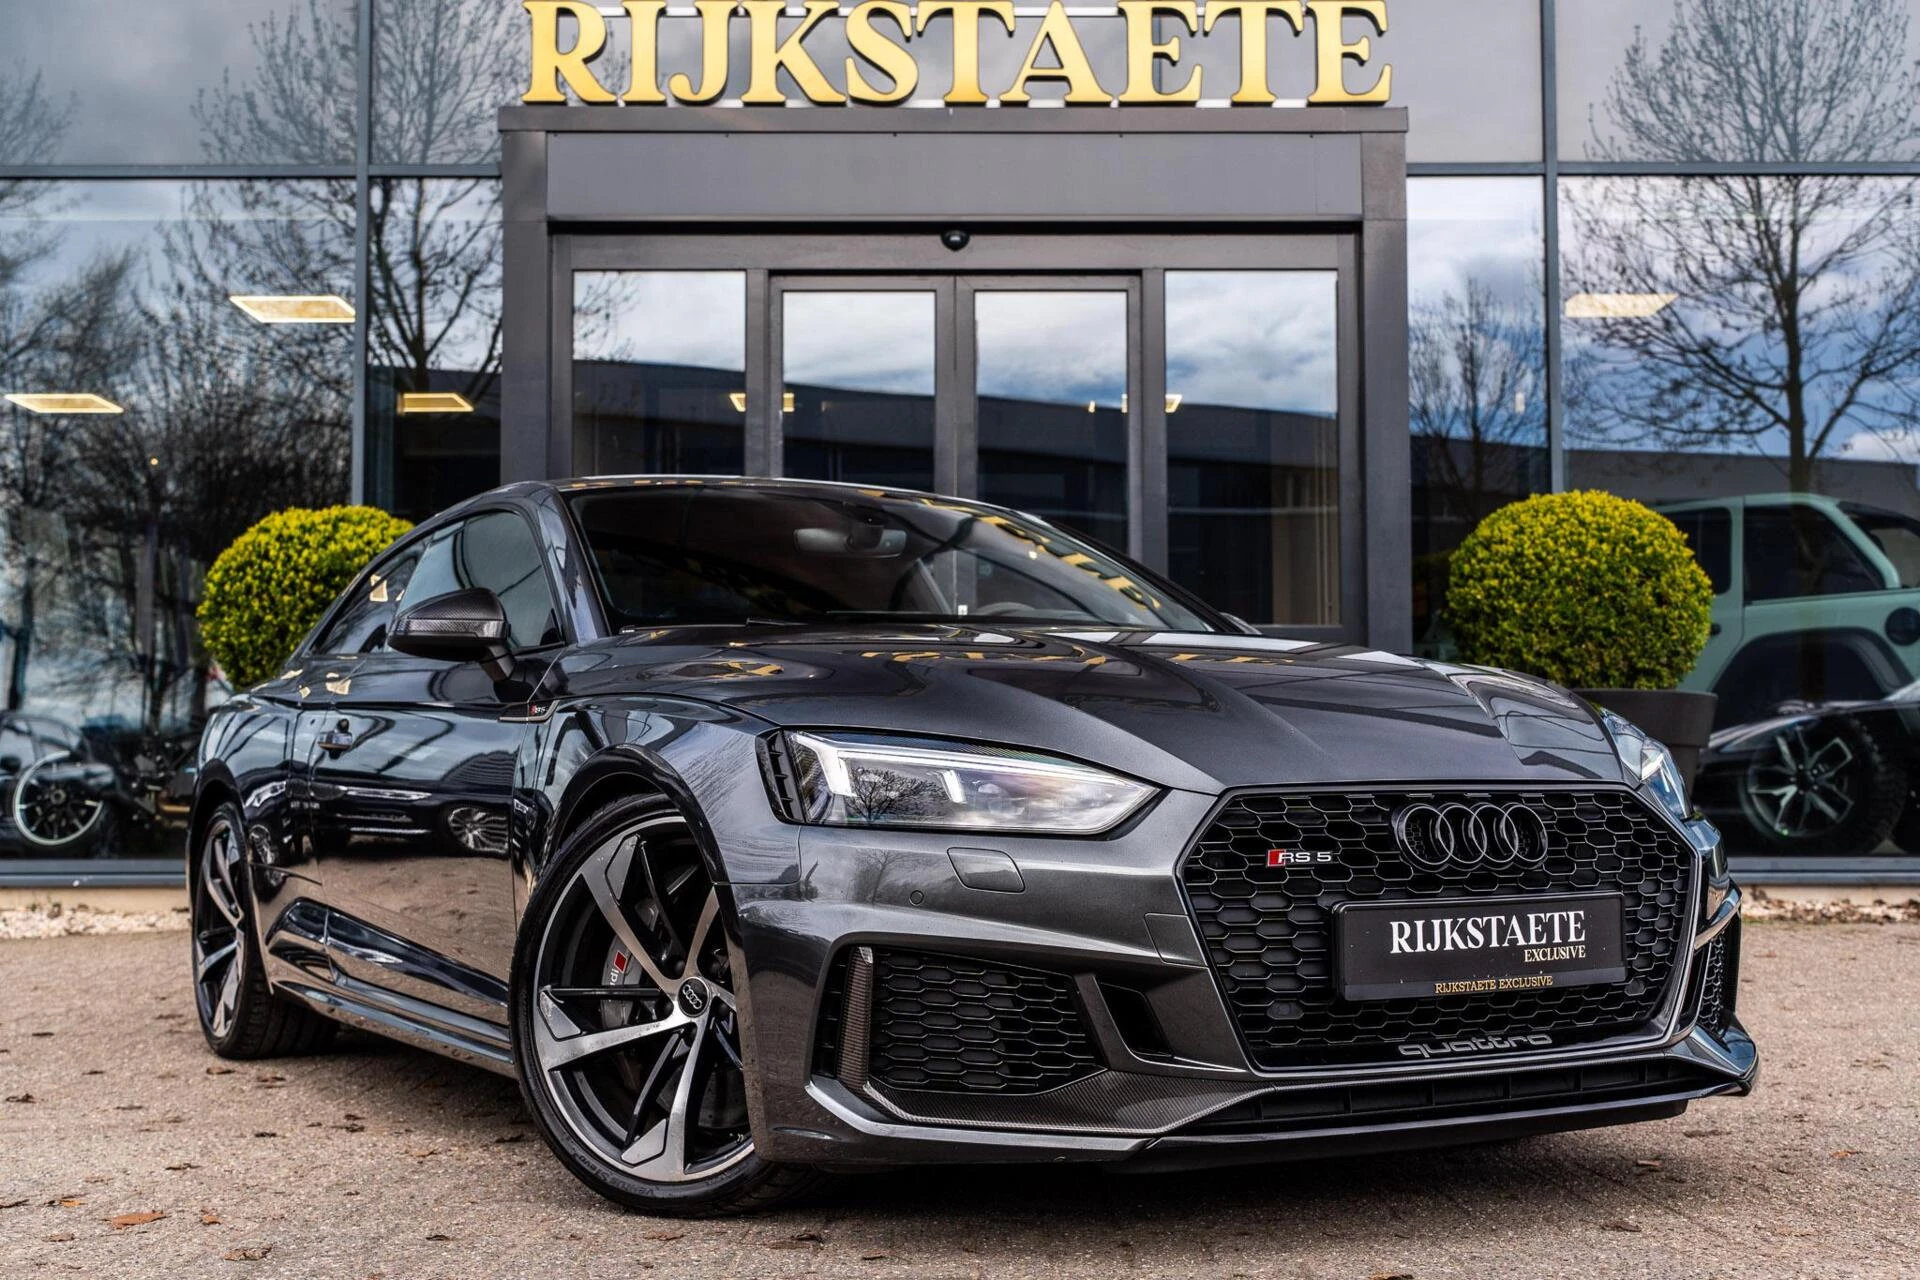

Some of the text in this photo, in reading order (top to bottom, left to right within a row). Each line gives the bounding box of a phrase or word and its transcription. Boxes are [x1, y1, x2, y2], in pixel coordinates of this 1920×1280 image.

[521, 0, 1392, 106] RIJKSTAETE
[1277, 851, 1332, 864] RS 5
[1389, 910, 1586, 954] RIJKSTAETE
[1524, 945, 1586, 963] EXCLUSIVE
[1435, 976, 1553, 994] RIJKSTAETE EXCLUSIVE
[1398, 1033, 1553, 1058] quattro
